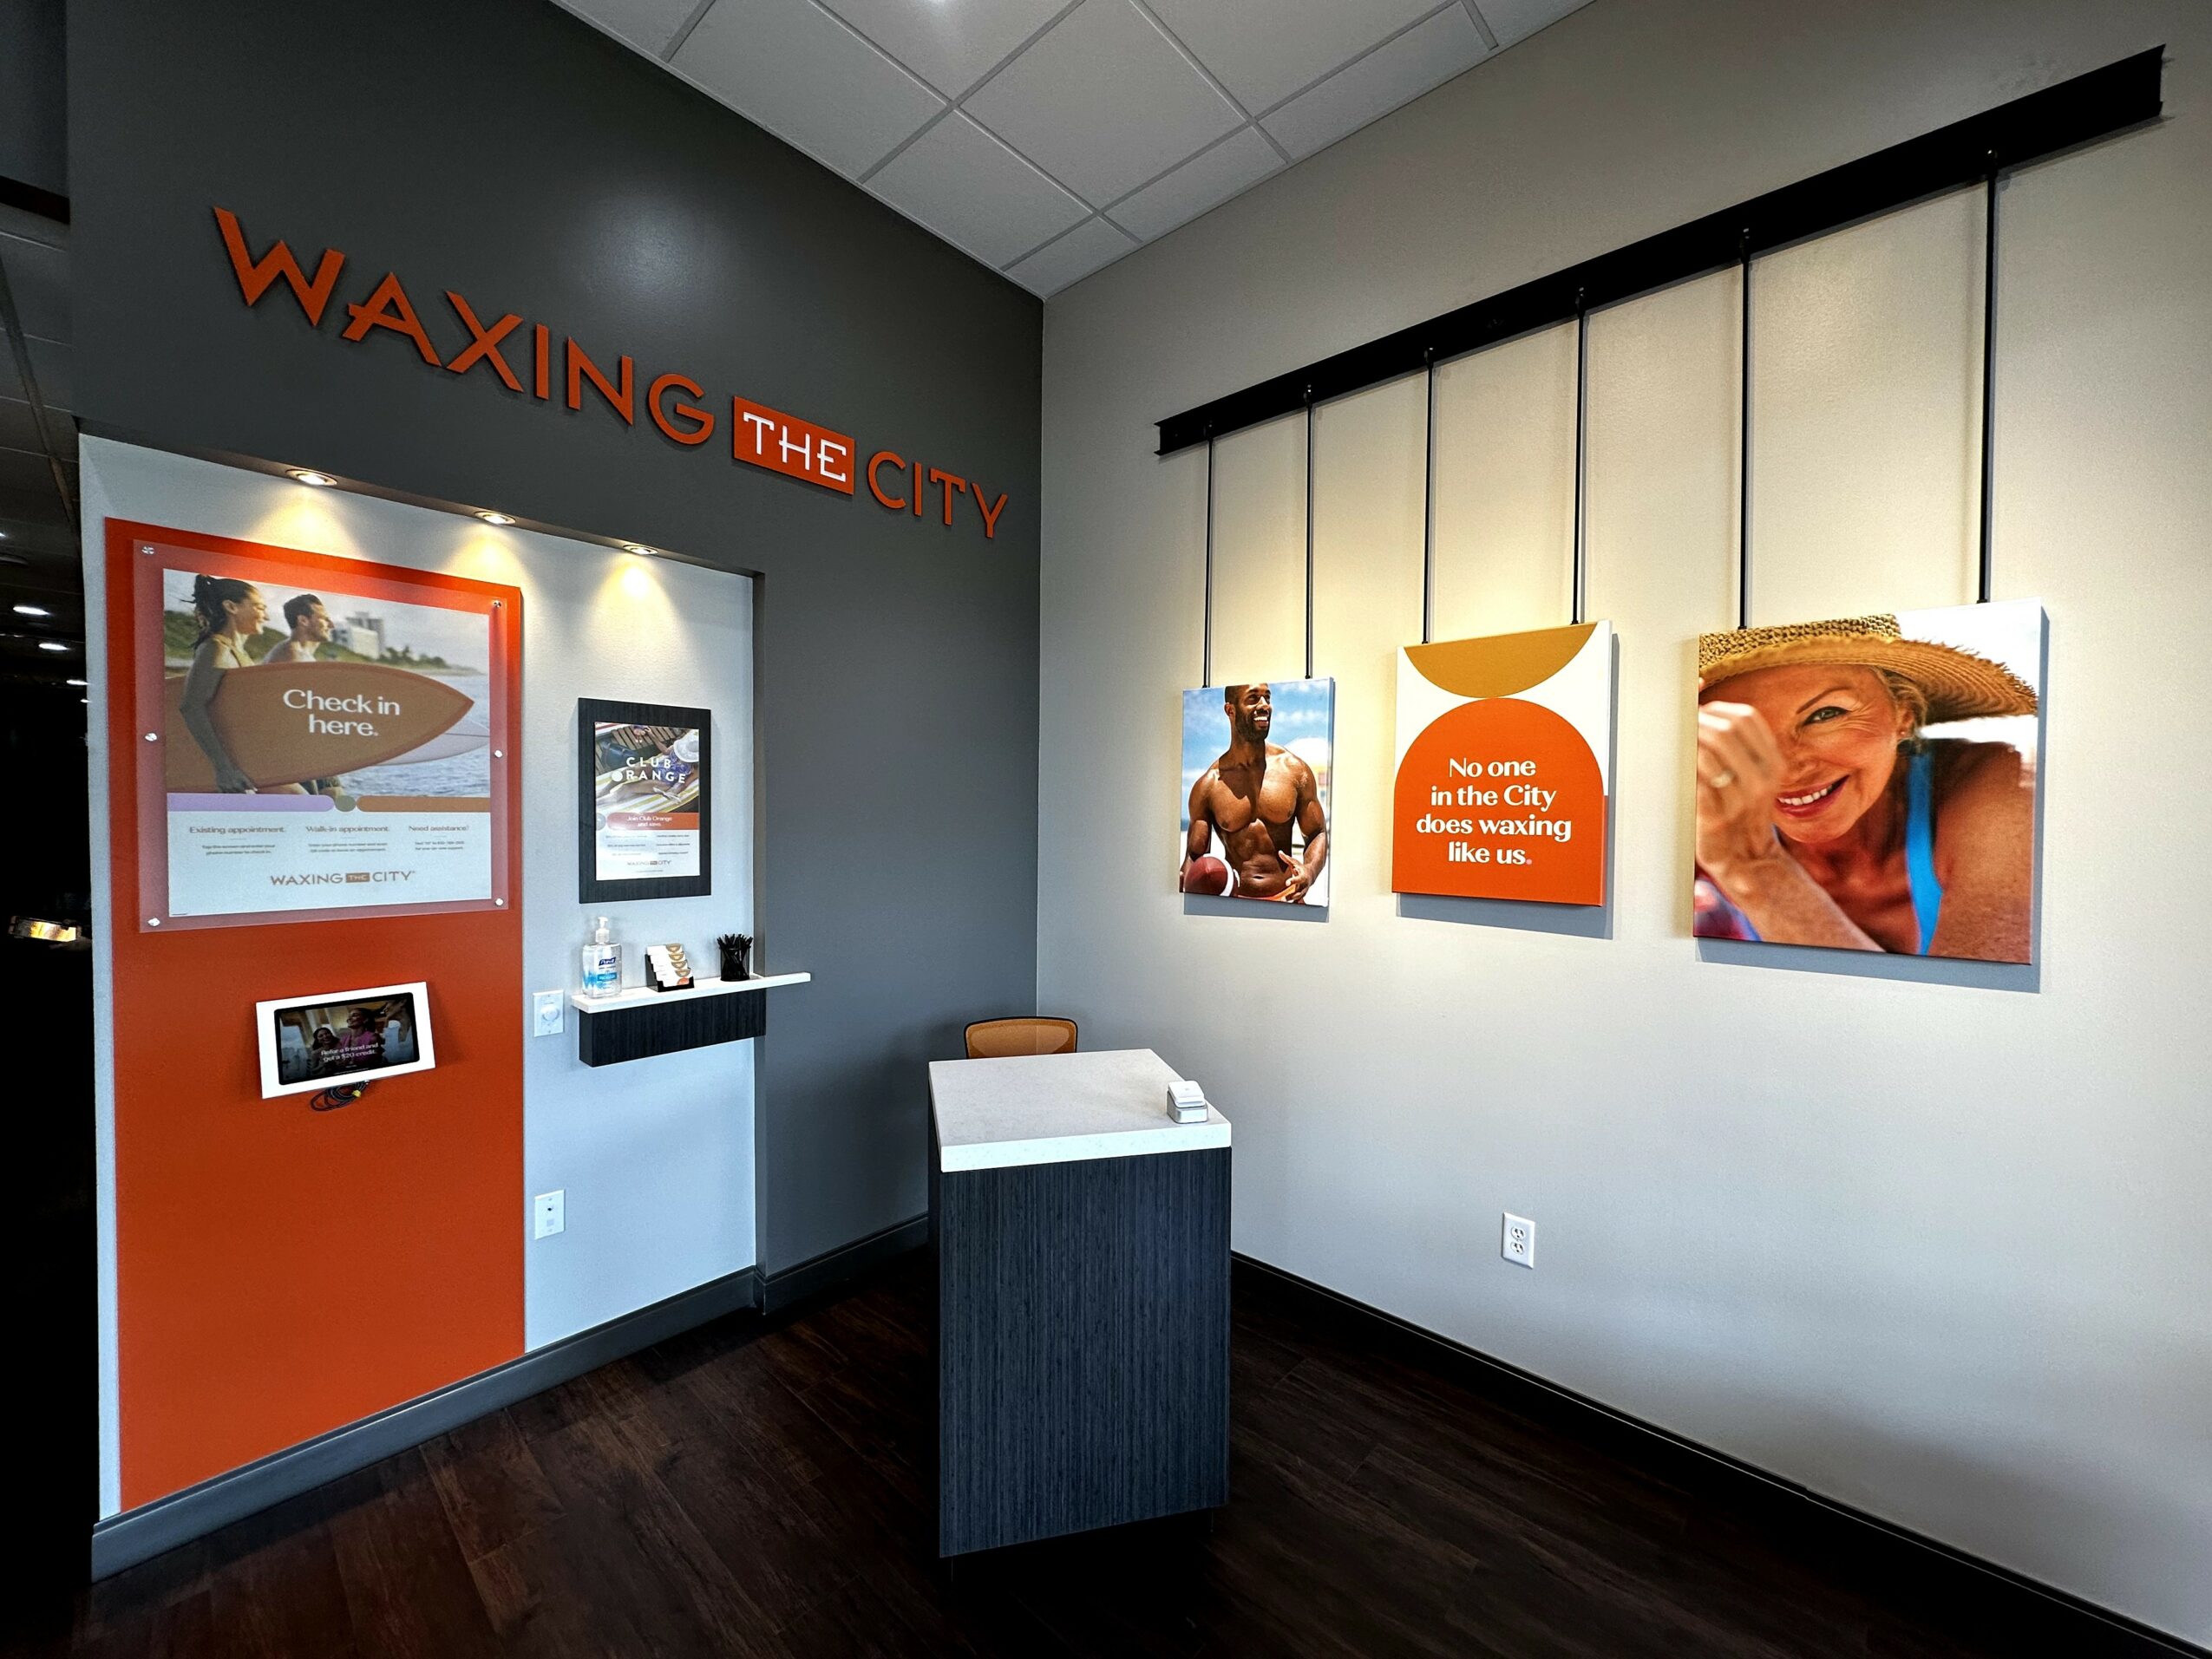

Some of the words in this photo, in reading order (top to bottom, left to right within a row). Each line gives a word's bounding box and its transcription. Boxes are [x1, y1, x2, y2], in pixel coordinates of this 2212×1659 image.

[213, 206, 715, 446] WAXING
[742, 410, 848, 485] THE
[867, 450, 1008, 539] CITY
[283, 689, 373, 714] Check
[377, 696, 401, 715] in
[309, 714, 378, 736] here.
[626, 757, 671, 768] CLUB
[1449, 757, 1482, 778] No
[1488, 760, 1536, 777] one
[1431, 786, 1452, 806] in
[1456, 786, 1498, 806] the
[1503, 784, 1556, 812] City
[189, 826, 226, 834] Existing
[1416, 813, 1473, 834] does
[1478, 814, 1572, 842] waxing
[1448, 841, 1490, 863] like
[1496, 848, 1533, 865] us.
[270, 872, 344, 885] WAXING
[372, 871, 412, 882] CITY
